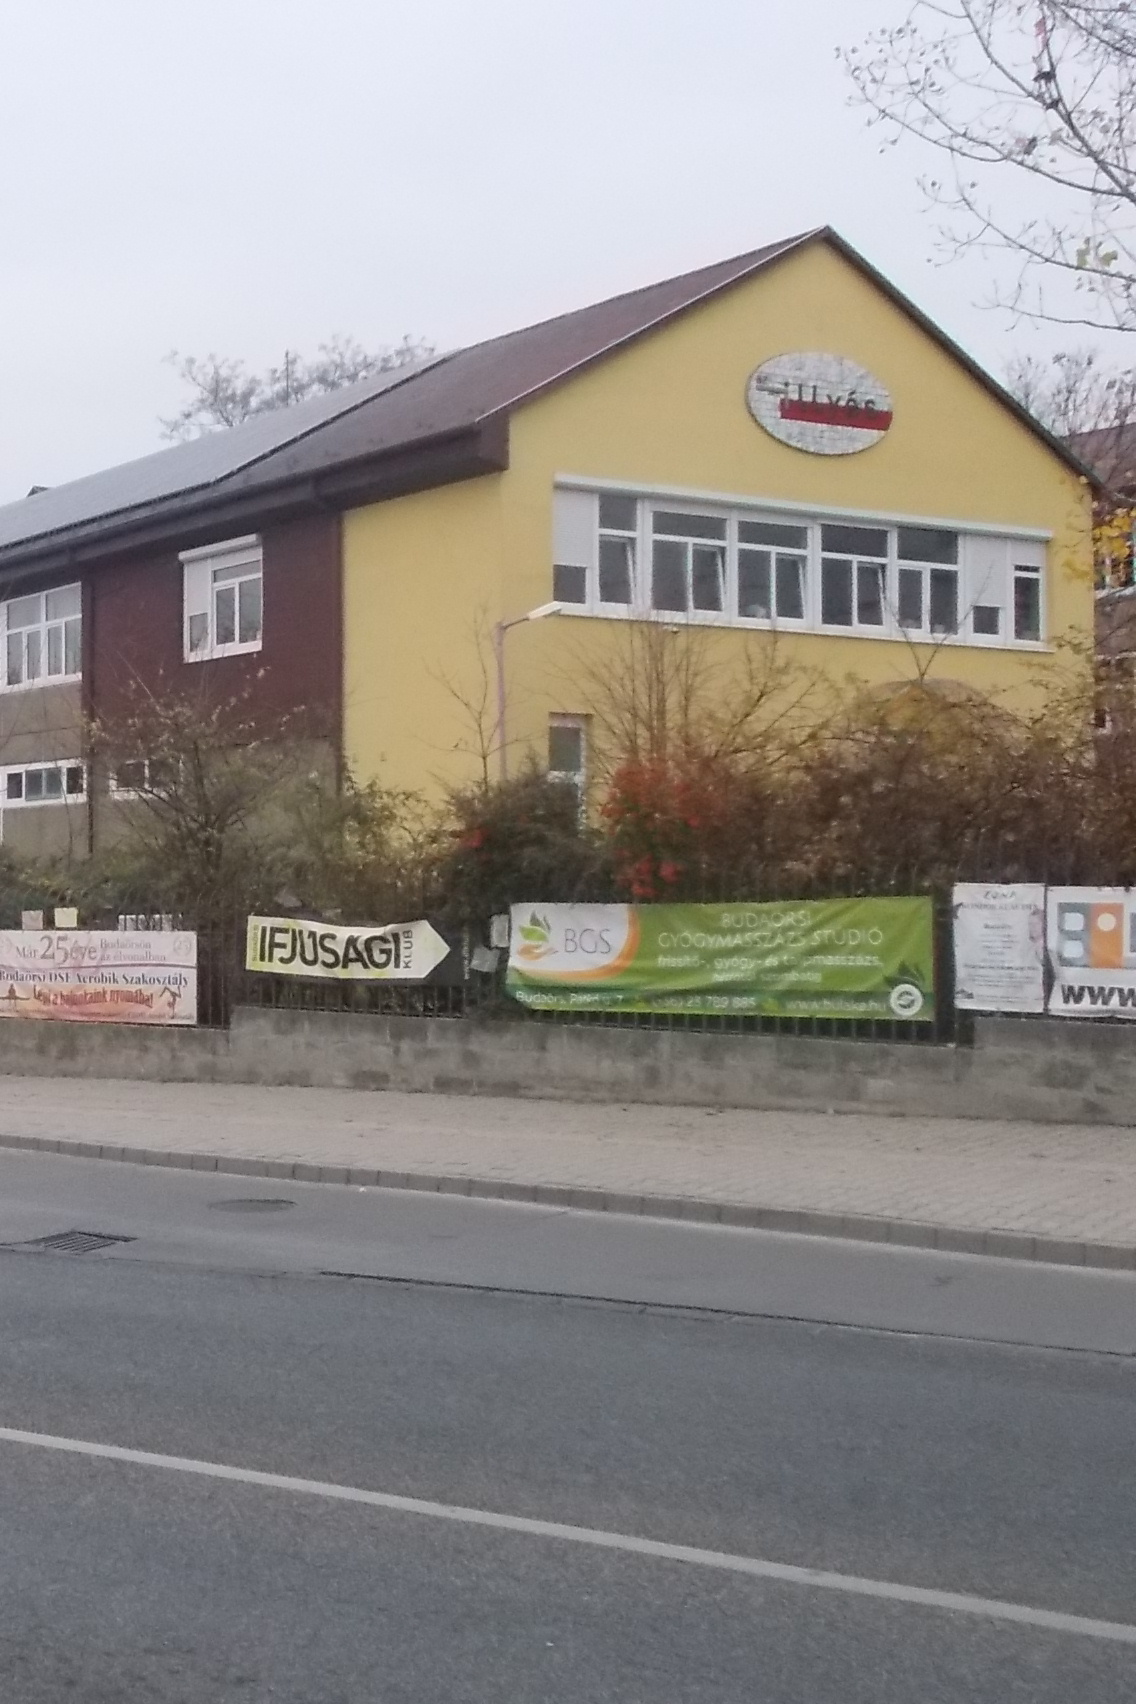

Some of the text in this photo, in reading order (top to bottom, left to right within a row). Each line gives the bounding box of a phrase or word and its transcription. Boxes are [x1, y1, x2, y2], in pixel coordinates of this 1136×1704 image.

[40, 934, 69, 966] 25
[70, 940, 97, 960] éve
[402, 929, 414, 970] KLUB
[0, 969, 46, 983] Budaörsi
[76, 972, 119, 985] Aerobik
[122, 972, 189, 988] Szakosztály
